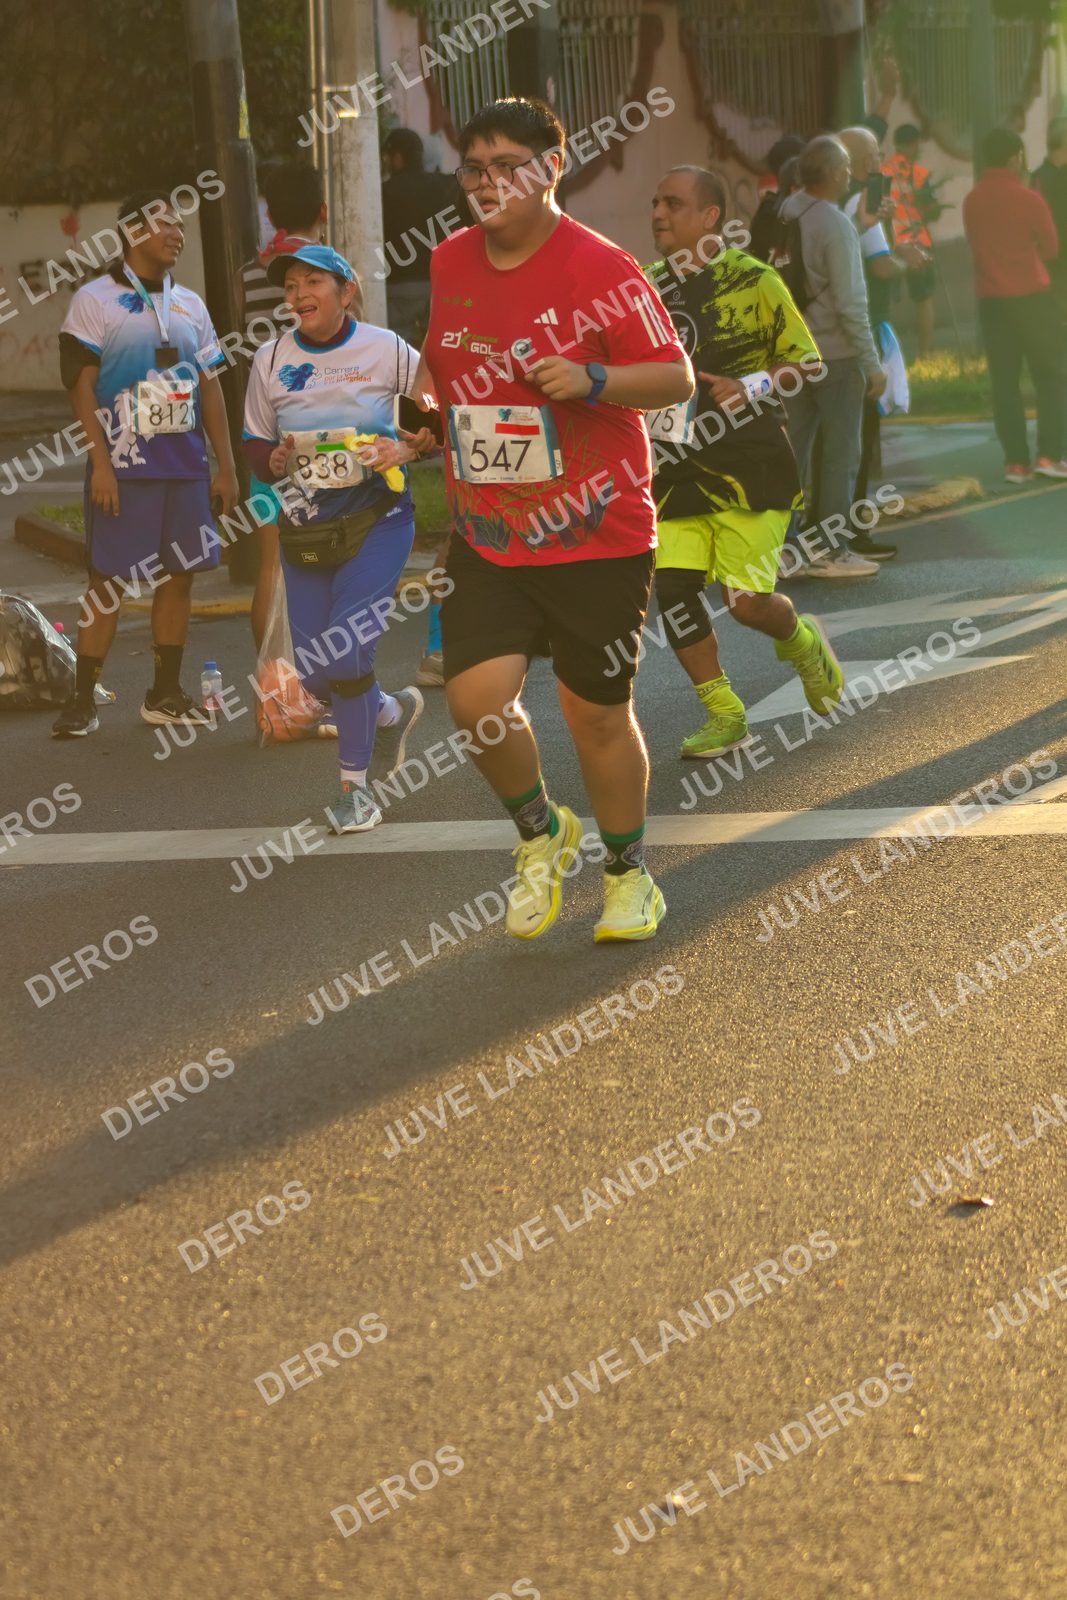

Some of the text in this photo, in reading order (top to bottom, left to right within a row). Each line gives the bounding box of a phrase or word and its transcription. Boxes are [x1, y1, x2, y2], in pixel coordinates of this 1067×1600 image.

[470, 342, 499, 356] GDL
[149, 403, 190, 427] 812
[296, 453, 349, 480] 838
[470, 440, 531, 473] 547
